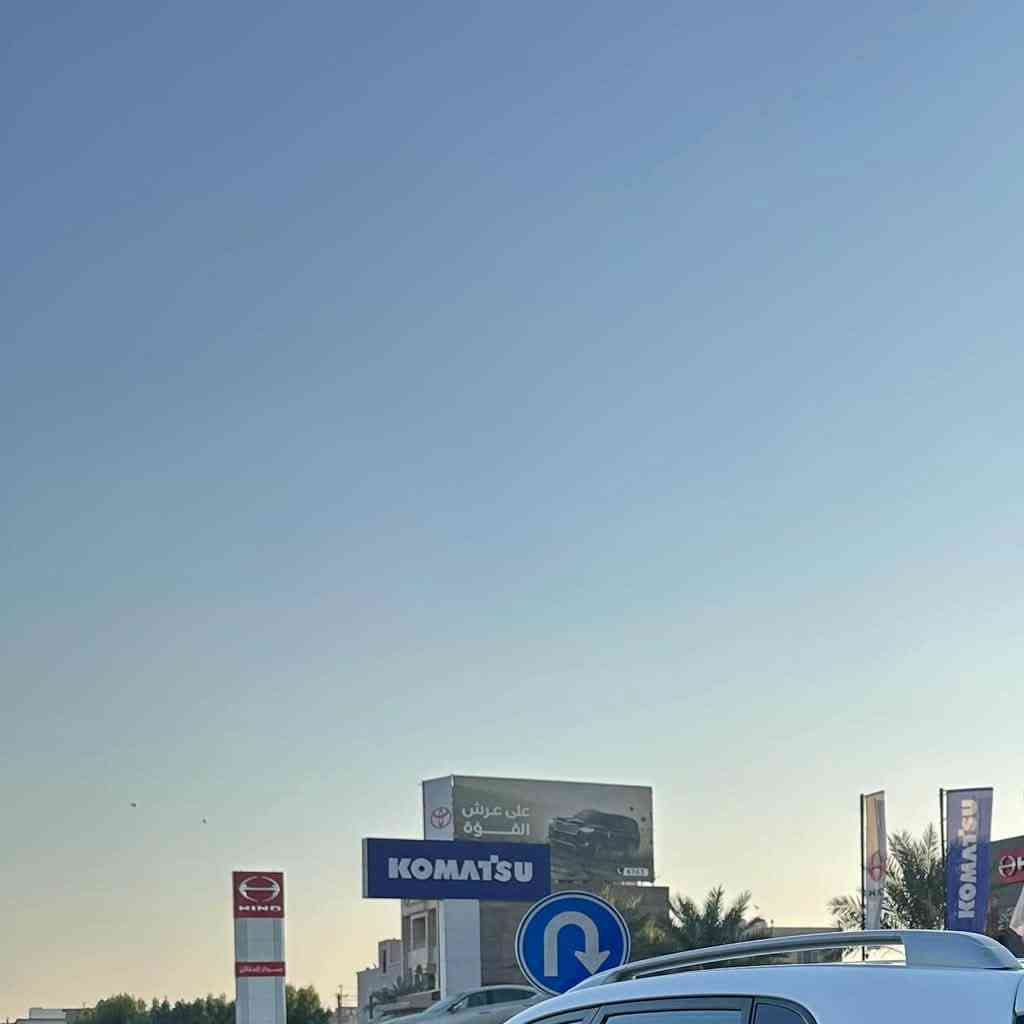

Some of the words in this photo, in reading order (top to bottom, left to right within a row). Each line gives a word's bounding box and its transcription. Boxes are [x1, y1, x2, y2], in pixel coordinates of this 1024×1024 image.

[461, 801, 502, 819] عرش
[505, 804, 531, 818] على
[958, 799, 977, 919] KOMATSU
[387, 854, 533, 883] KOMATSU
[238, 904, 281, 912] HINO
